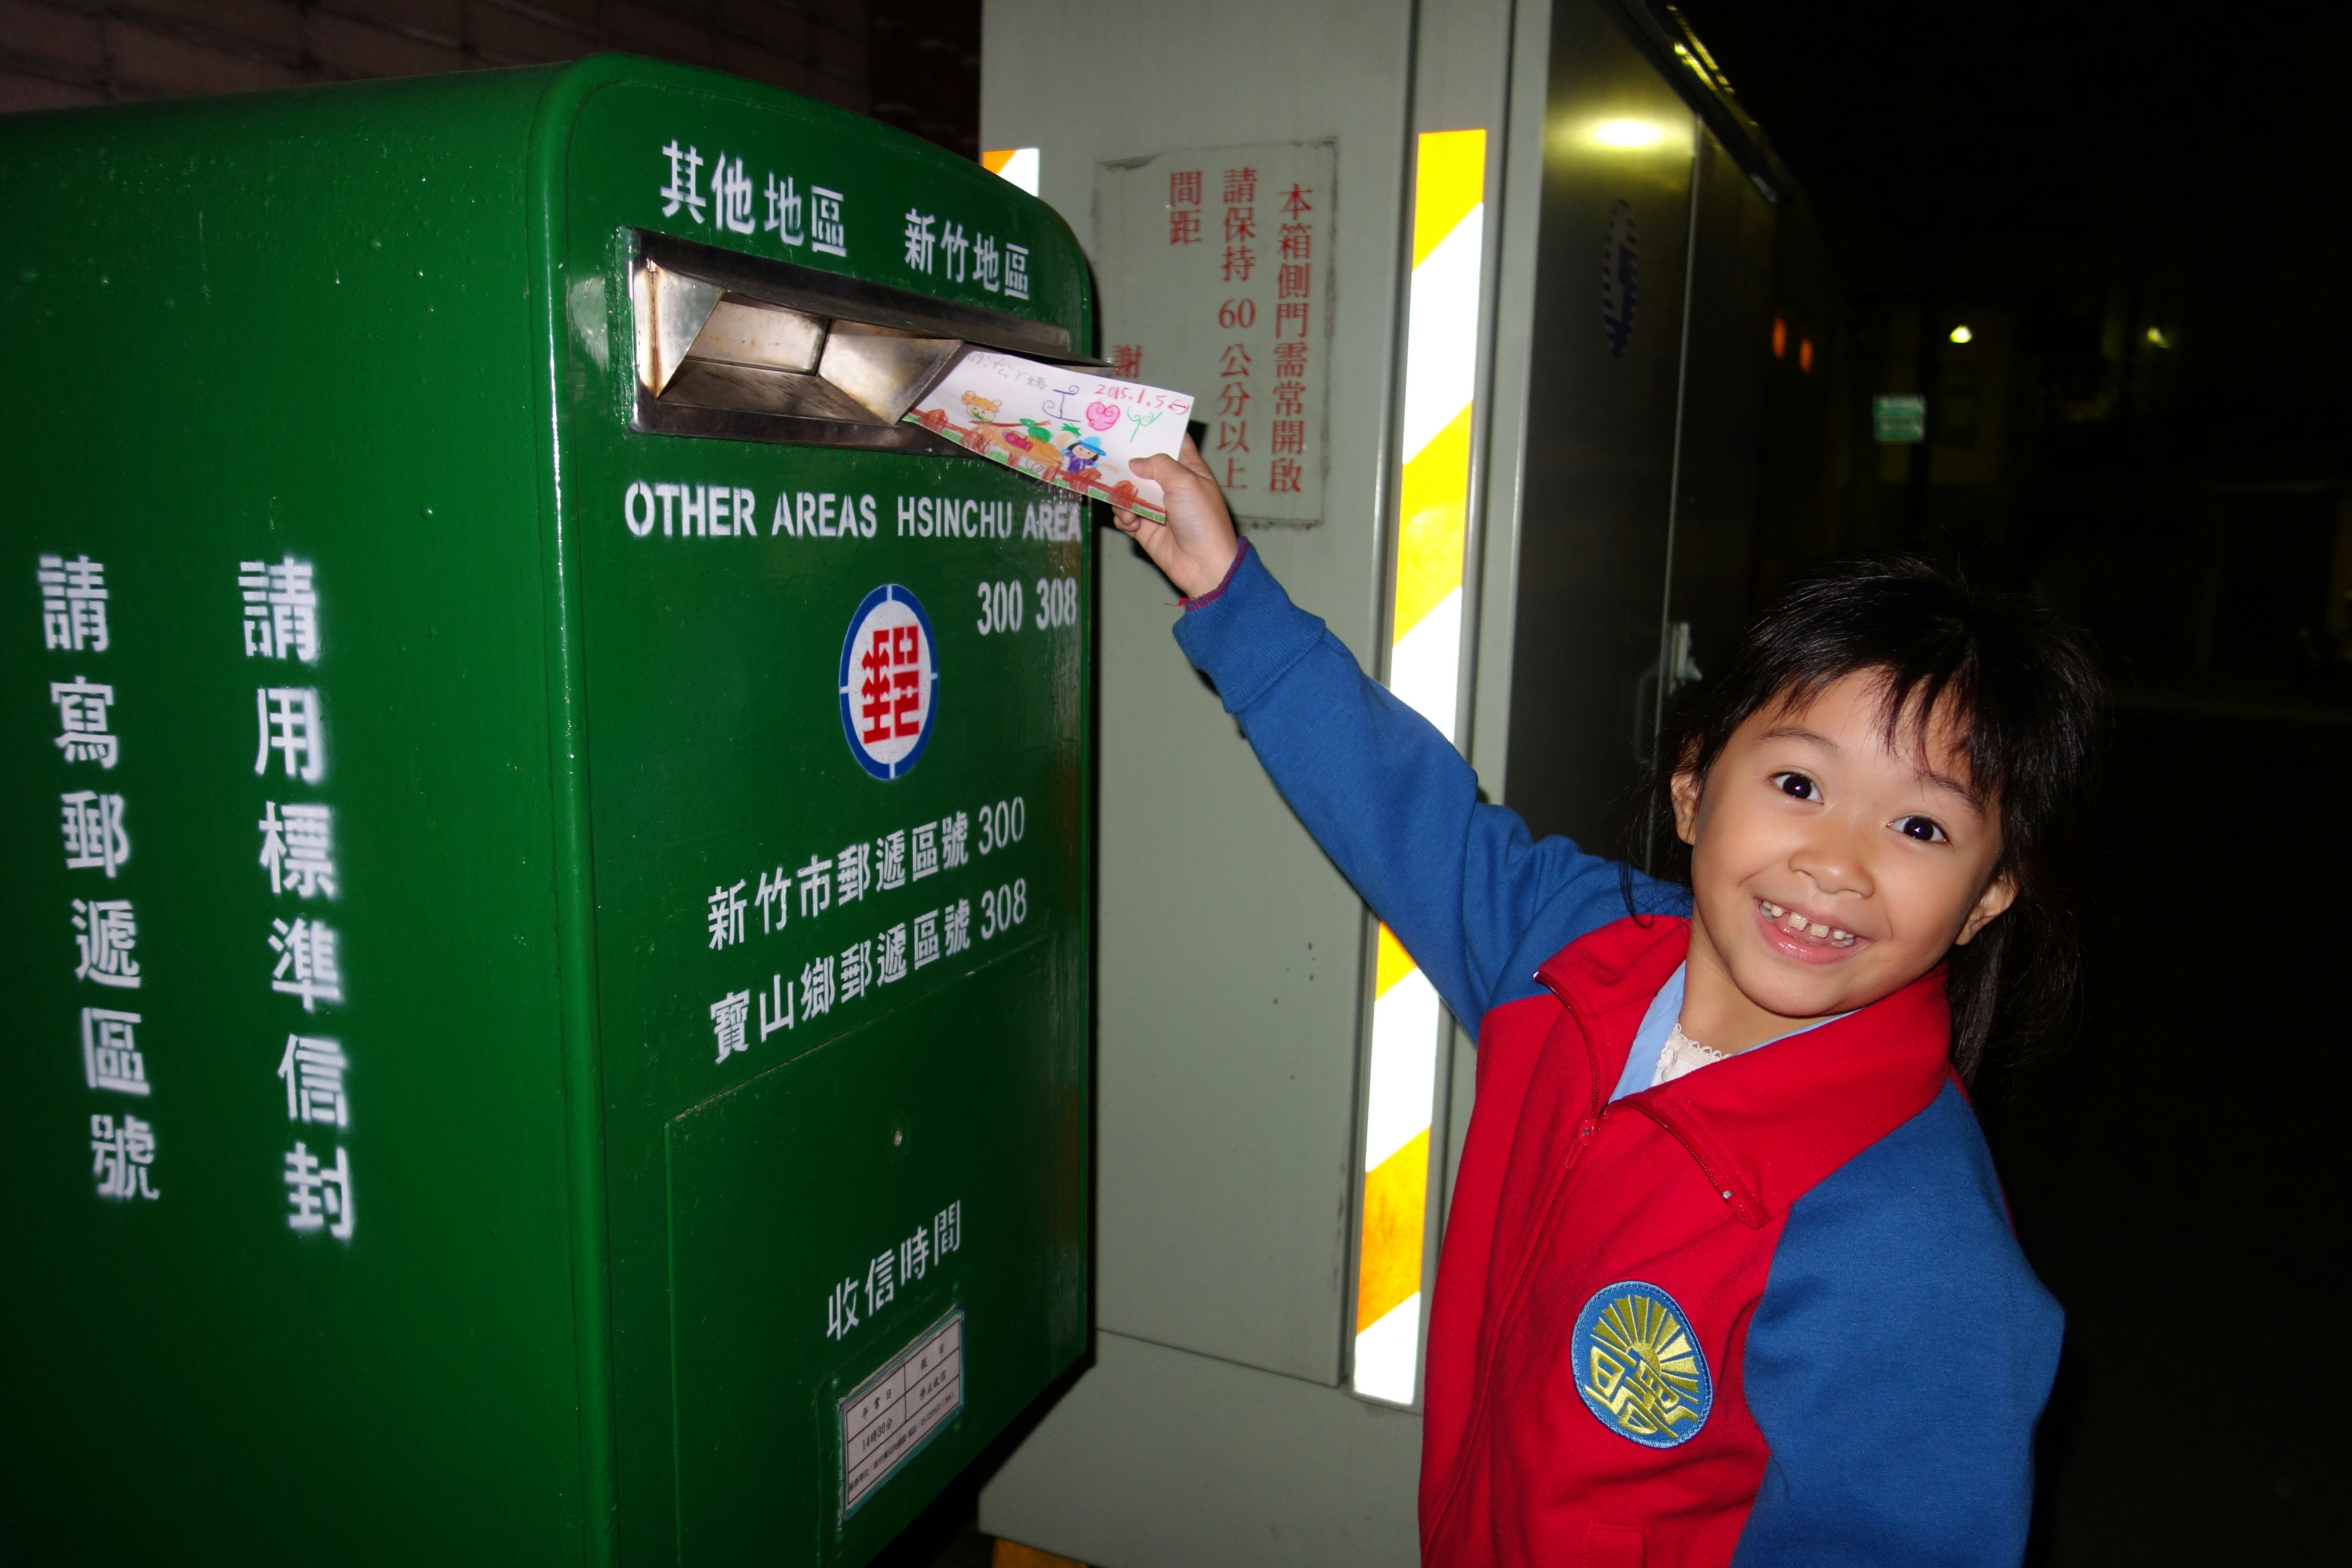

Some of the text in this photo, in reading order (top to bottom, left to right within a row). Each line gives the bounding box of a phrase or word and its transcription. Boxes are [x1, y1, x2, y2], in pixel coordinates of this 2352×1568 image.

[661, 141, 845, 257] 其他地區
[1170, 171, 1202, 245] 間距
[905, 208, 1028, 299] 新竹地區
[1217, 167, 1257, 492] 請保持 60 公分以上
[1269, 184, 1313, 493] 本箱側門需常開啟
[625, 482, 876, 538] OTHER AREAS
[898, 497, 1082, 542] HSINCHU AREA
[977, 578, 1076, 635] 300 308
[38, 556, 159, 1199] 請寫郵遞區號
[239, 556, 353, 1239] 請用標準信封
[707, 797, 1024, 950] 新竹市郵遞區號 300
[710, 879, 1026, 1065] 寶山鄉郵遞區號 308
[827, 1200, 961, 1341] 收信時間
[862, 1388, 891, 1420] 平常日
[863, 1418, 893, 1452] 14時30分
[919, 1371, 946, 1400] 停止收信
